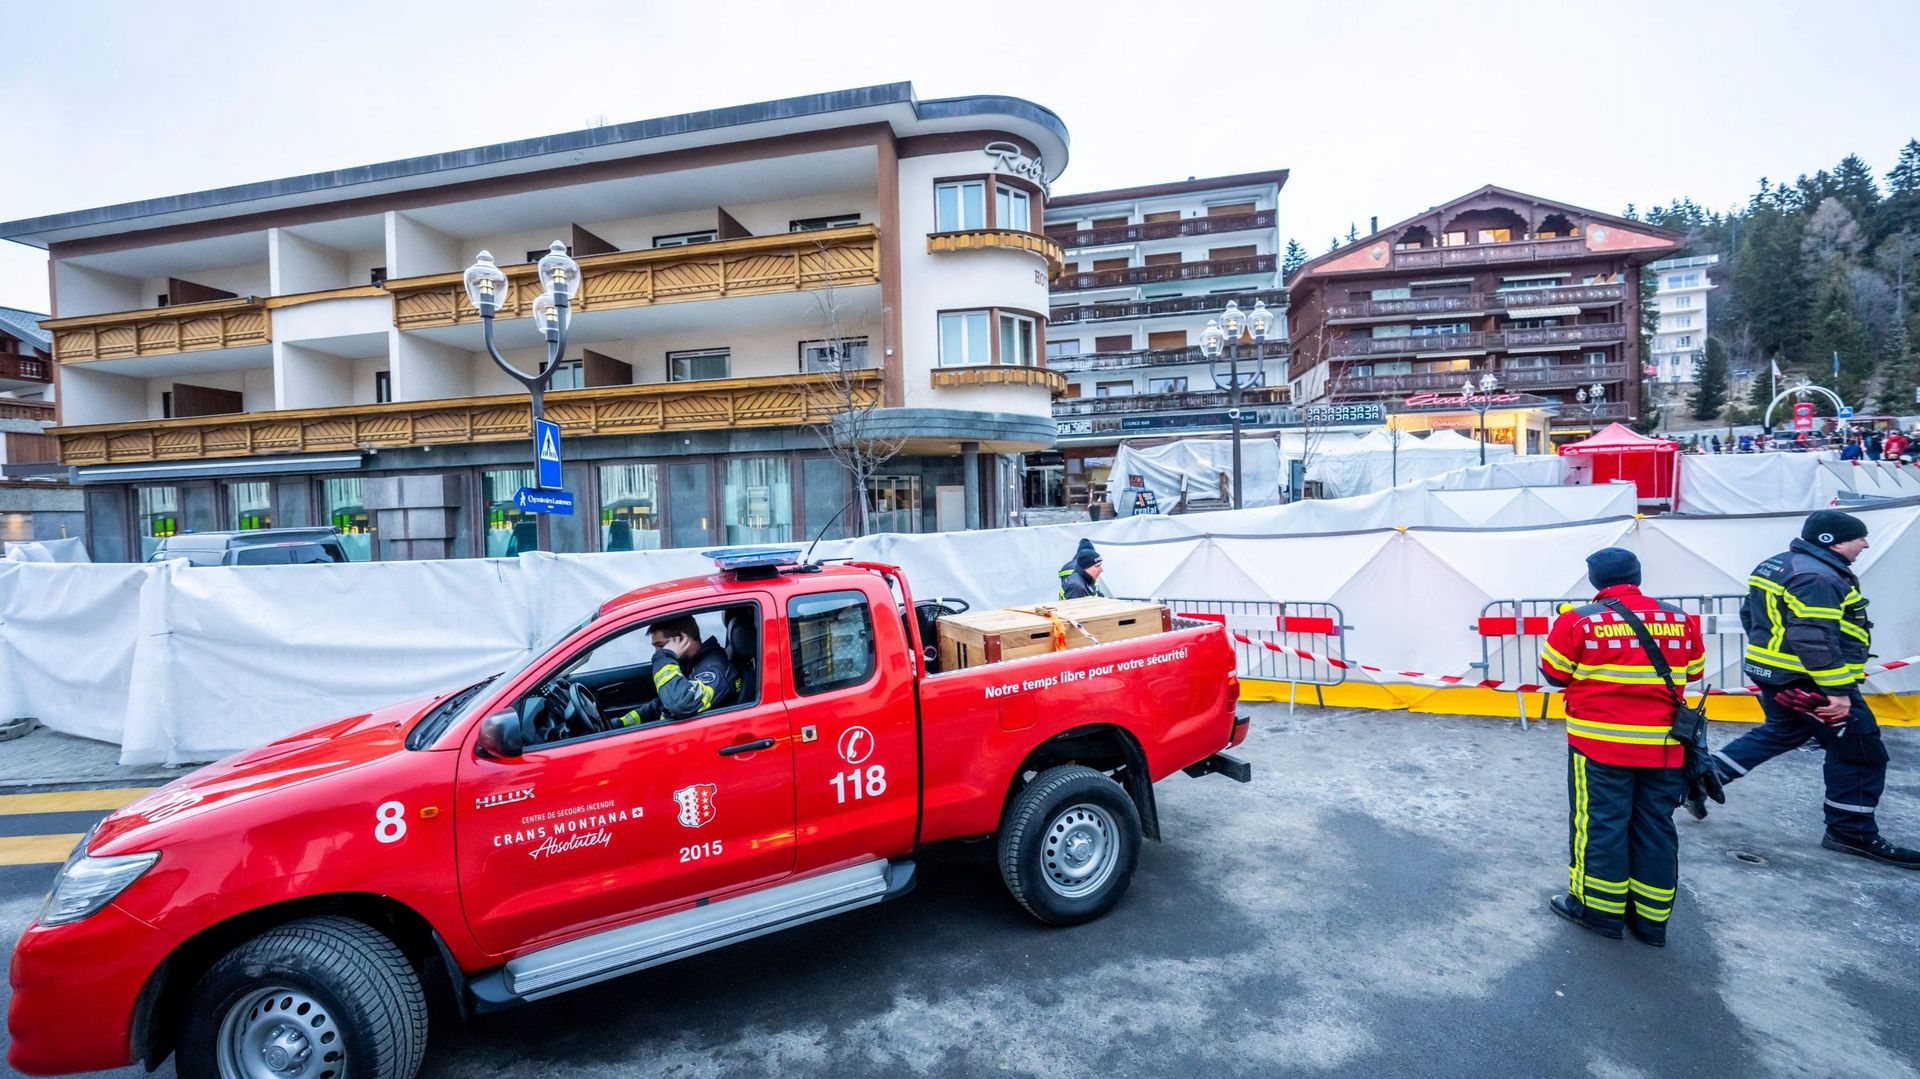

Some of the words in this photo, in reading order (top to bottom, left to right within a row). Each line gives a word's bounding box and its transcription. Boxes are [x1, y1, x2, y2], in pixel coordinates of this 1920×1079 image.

[1594, 623, 1685, 638] COMMNDANT
[985, 682, 1019, 699] Notre
[1022, 675, 1058, 692] temps
[1060, 670, 1086, 684] libre
[1088, 664, 1114, 680] pour
[1117, 657, 1145, 672] votre
[1146, 647, 1188, 666] sécurité!
[476, 787, 536, 809] HILUX
[829, 764, 887, 804] 118
[374, 800, 407, 844] 8
[521, 814, 546, 824] CENTRE
[547, 812, 555, 820] DE
[556, 806, 585, 817] SECOURS
[586, 800, 615, 811] INCENDIE
[493, 826, 546, 847] CRANS
[554, 811, 628, 835] MONTANA
[528, 828, 613, 860] Absolutely
[679, 839, 723, 863] 2015
